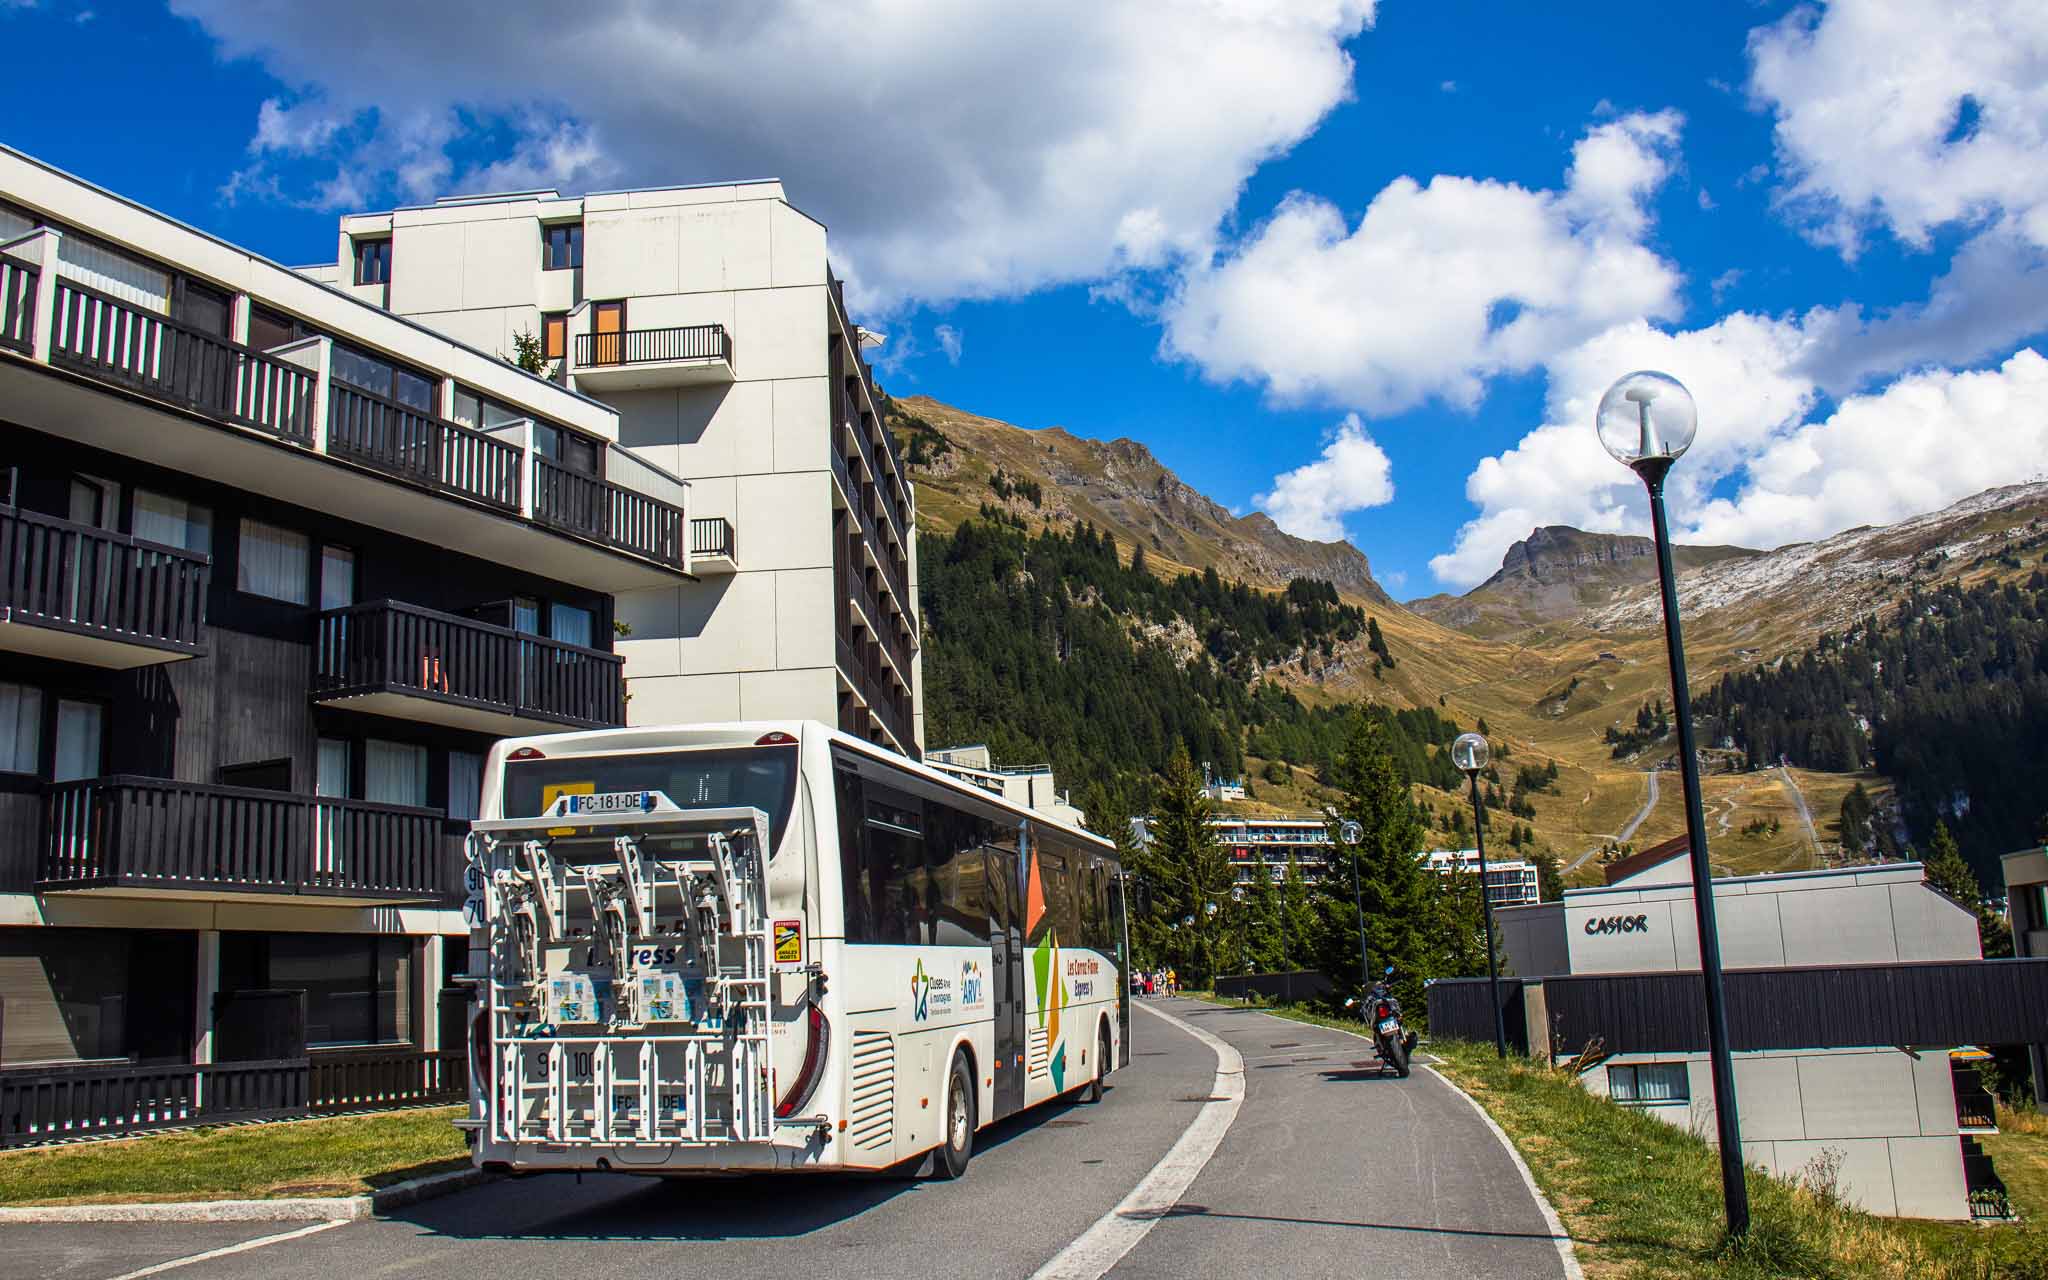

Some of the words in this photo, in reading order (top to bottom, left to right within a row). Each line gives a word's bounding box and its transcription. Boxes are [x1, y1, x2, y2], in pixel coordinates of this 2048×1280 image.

[579, 793, 640, 810] FC-181-DE
[469, 866, 485, 891] 90
[468, 898, 485, 923] 70
[1584, 914, 1649, 936] CASTOR
